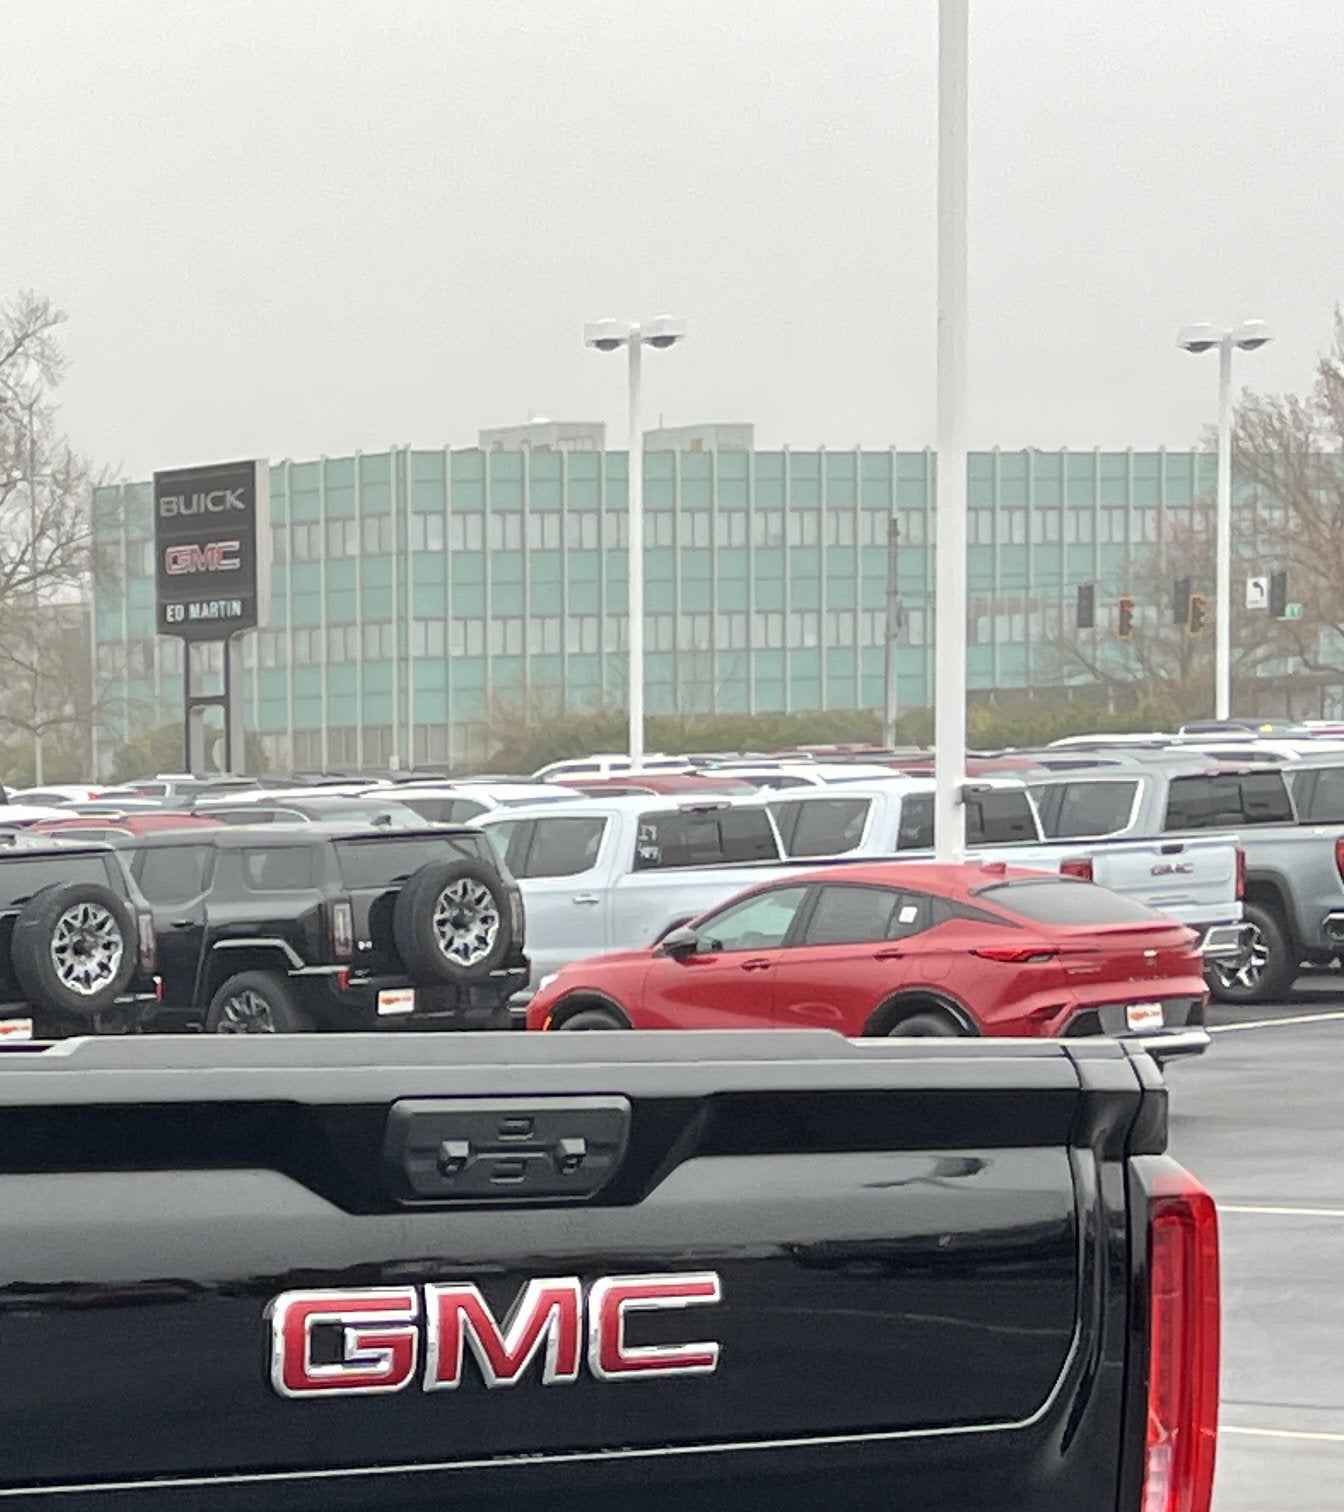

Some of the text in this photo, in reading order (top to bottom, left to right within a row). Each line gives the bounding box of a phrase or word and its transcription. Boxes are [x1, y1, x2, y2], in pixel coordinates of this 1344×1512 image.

[159, 488, 245, 517] BUICK
[165, 540, 240, 575] GMC
[166, 600, 242, 622] ED MARTIN
[269, 1271, 720, 1398] GMC
